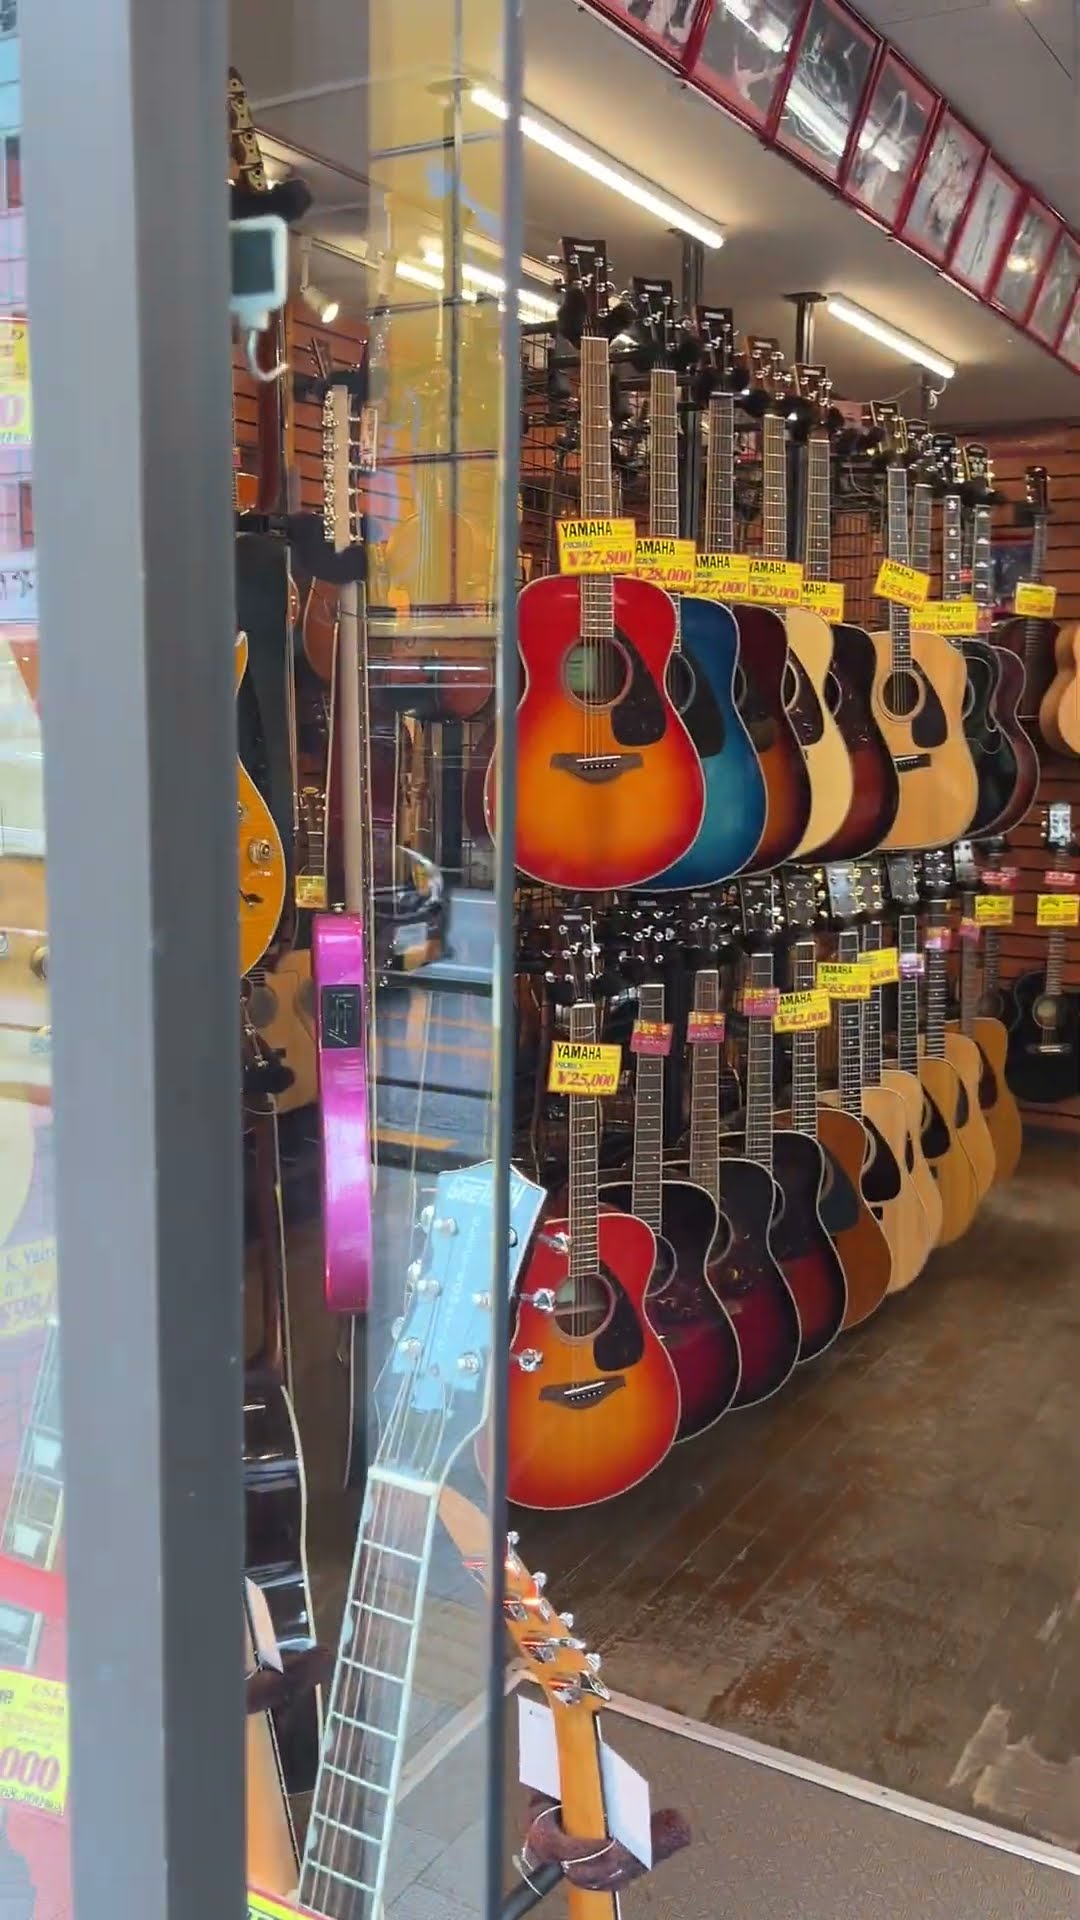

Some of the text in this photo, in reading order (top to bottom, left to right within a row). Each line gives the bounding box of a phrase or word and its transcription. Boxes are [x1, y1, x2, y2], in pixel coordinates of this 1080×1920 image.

[561, 521, 613, 537] YAMAHA
[636, 540, 676, 555] AMAHA
[695, 555, 728, 568] MAHA
[802, 581, 827, 595] MAHA
[779, 991, 813, 1006] AMAHA
[557, 1044, 602, 1060] YAMAHA
[558, 1071, 615, 1088] ¥25,000
